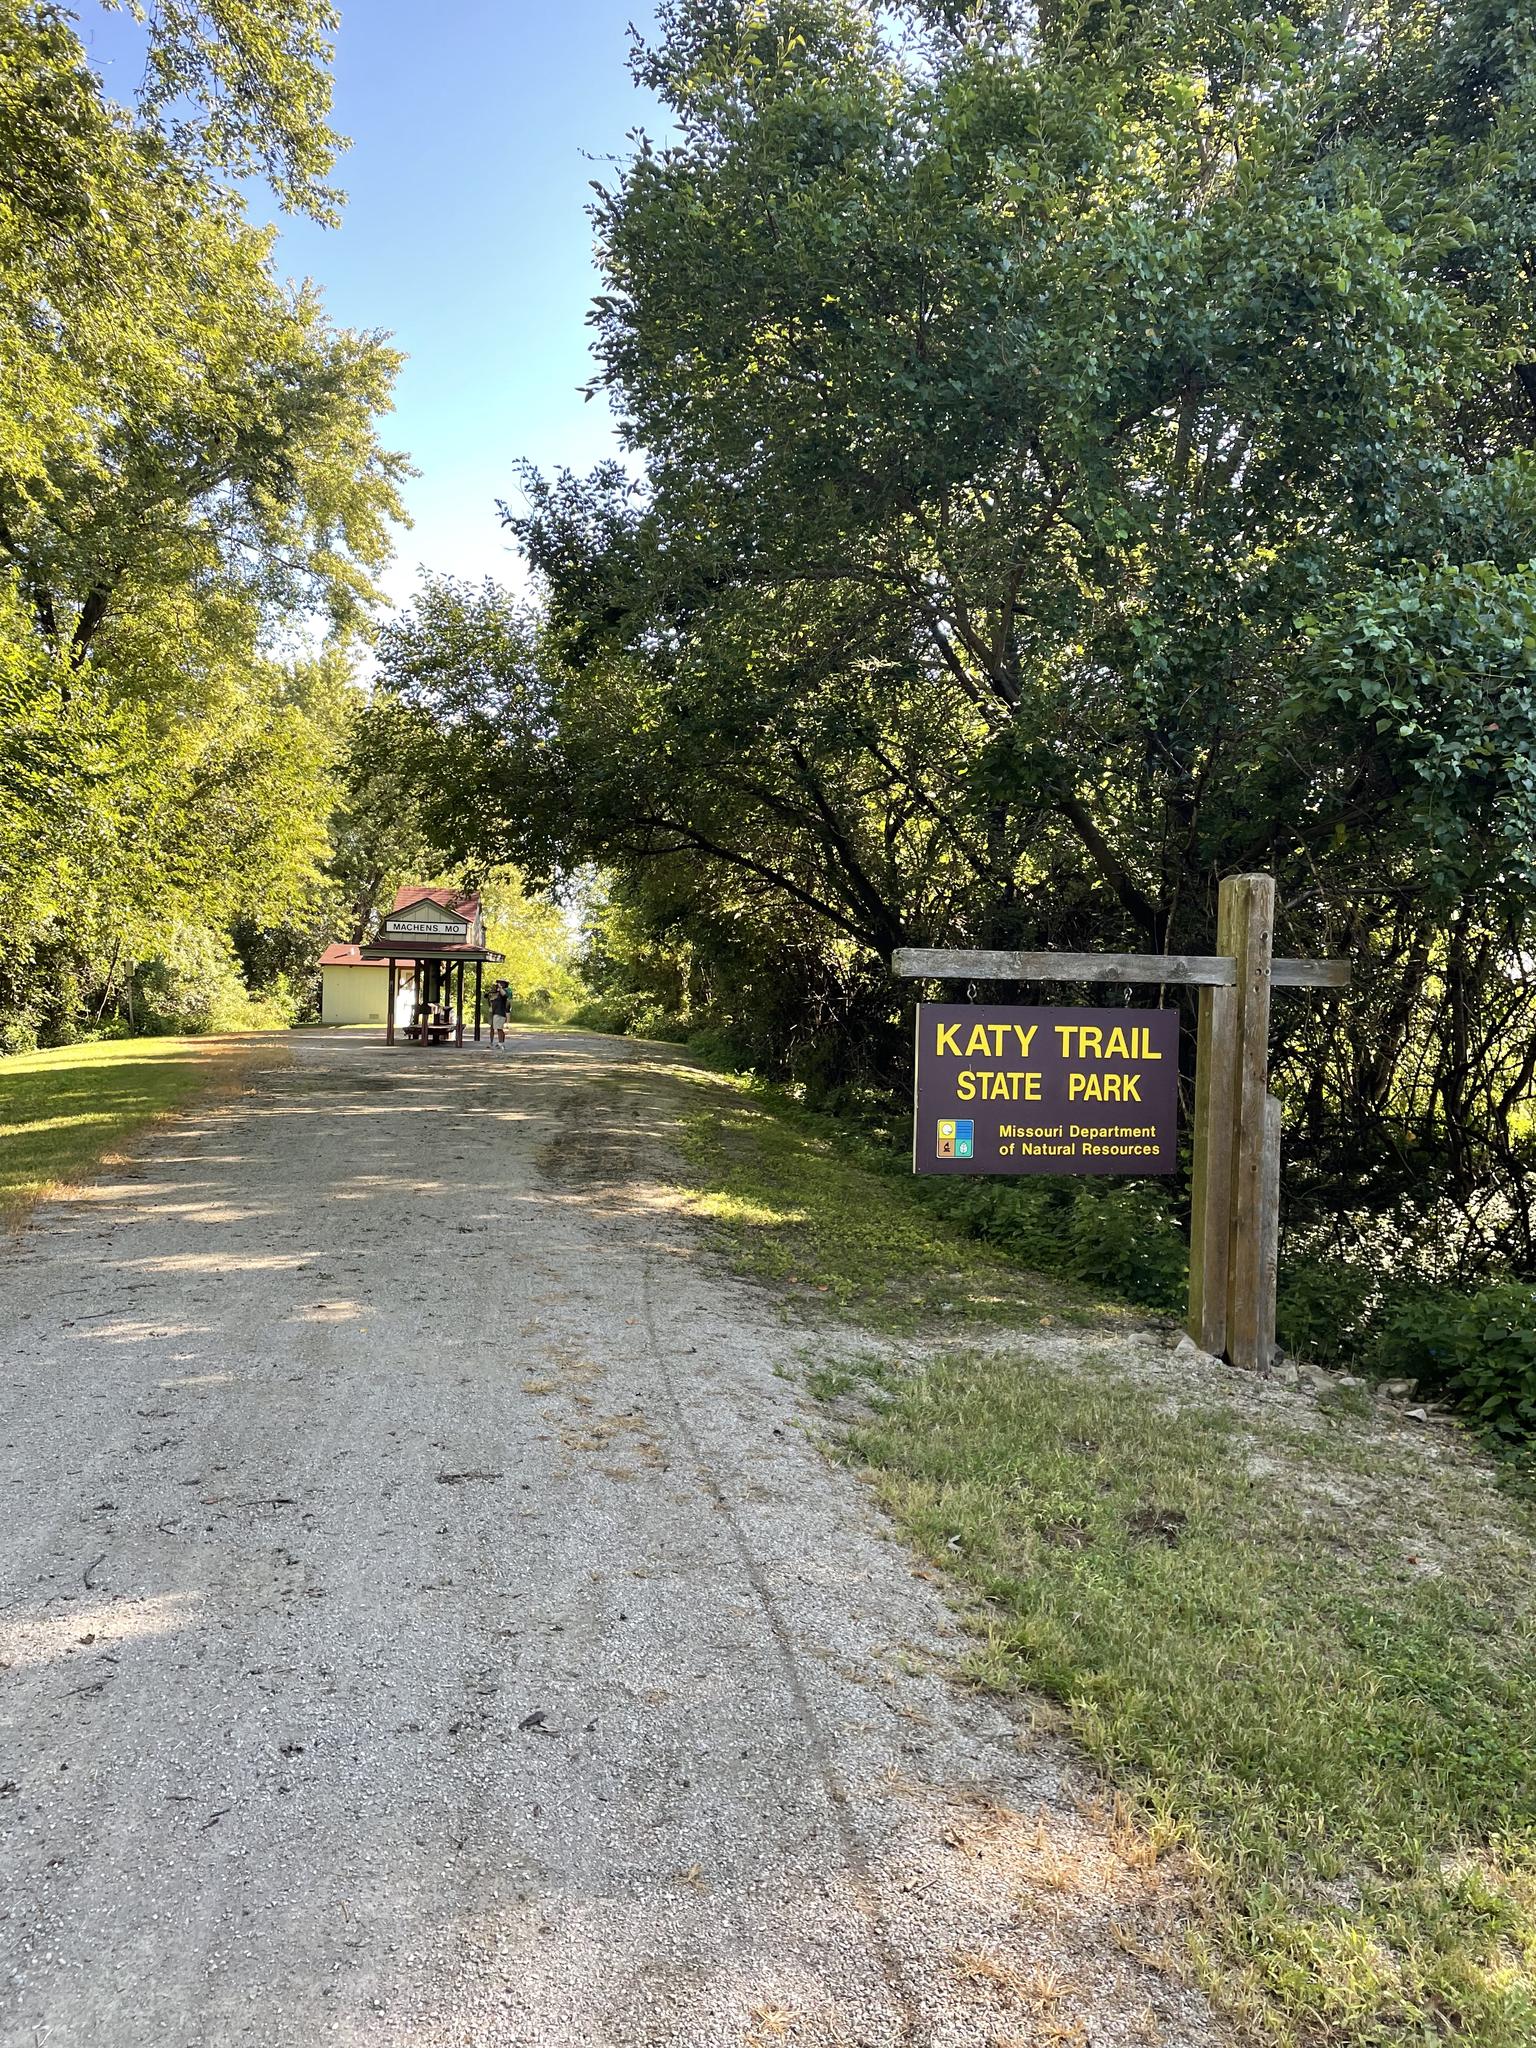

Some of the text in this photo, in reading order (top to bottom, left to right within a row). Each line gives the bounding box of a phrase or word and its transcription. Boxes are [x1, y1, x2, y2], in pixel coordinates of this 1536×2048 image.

[444, 925, 460, 933] MO
[936, 1023, 1162, 1060] KATY TRAIL
[956, 1071, 1142, 1102] STATE PARK
[999, 1125, 1156, 1141] Missouri Department
[999, 1142, 1160, 1156] of Natural Resources
